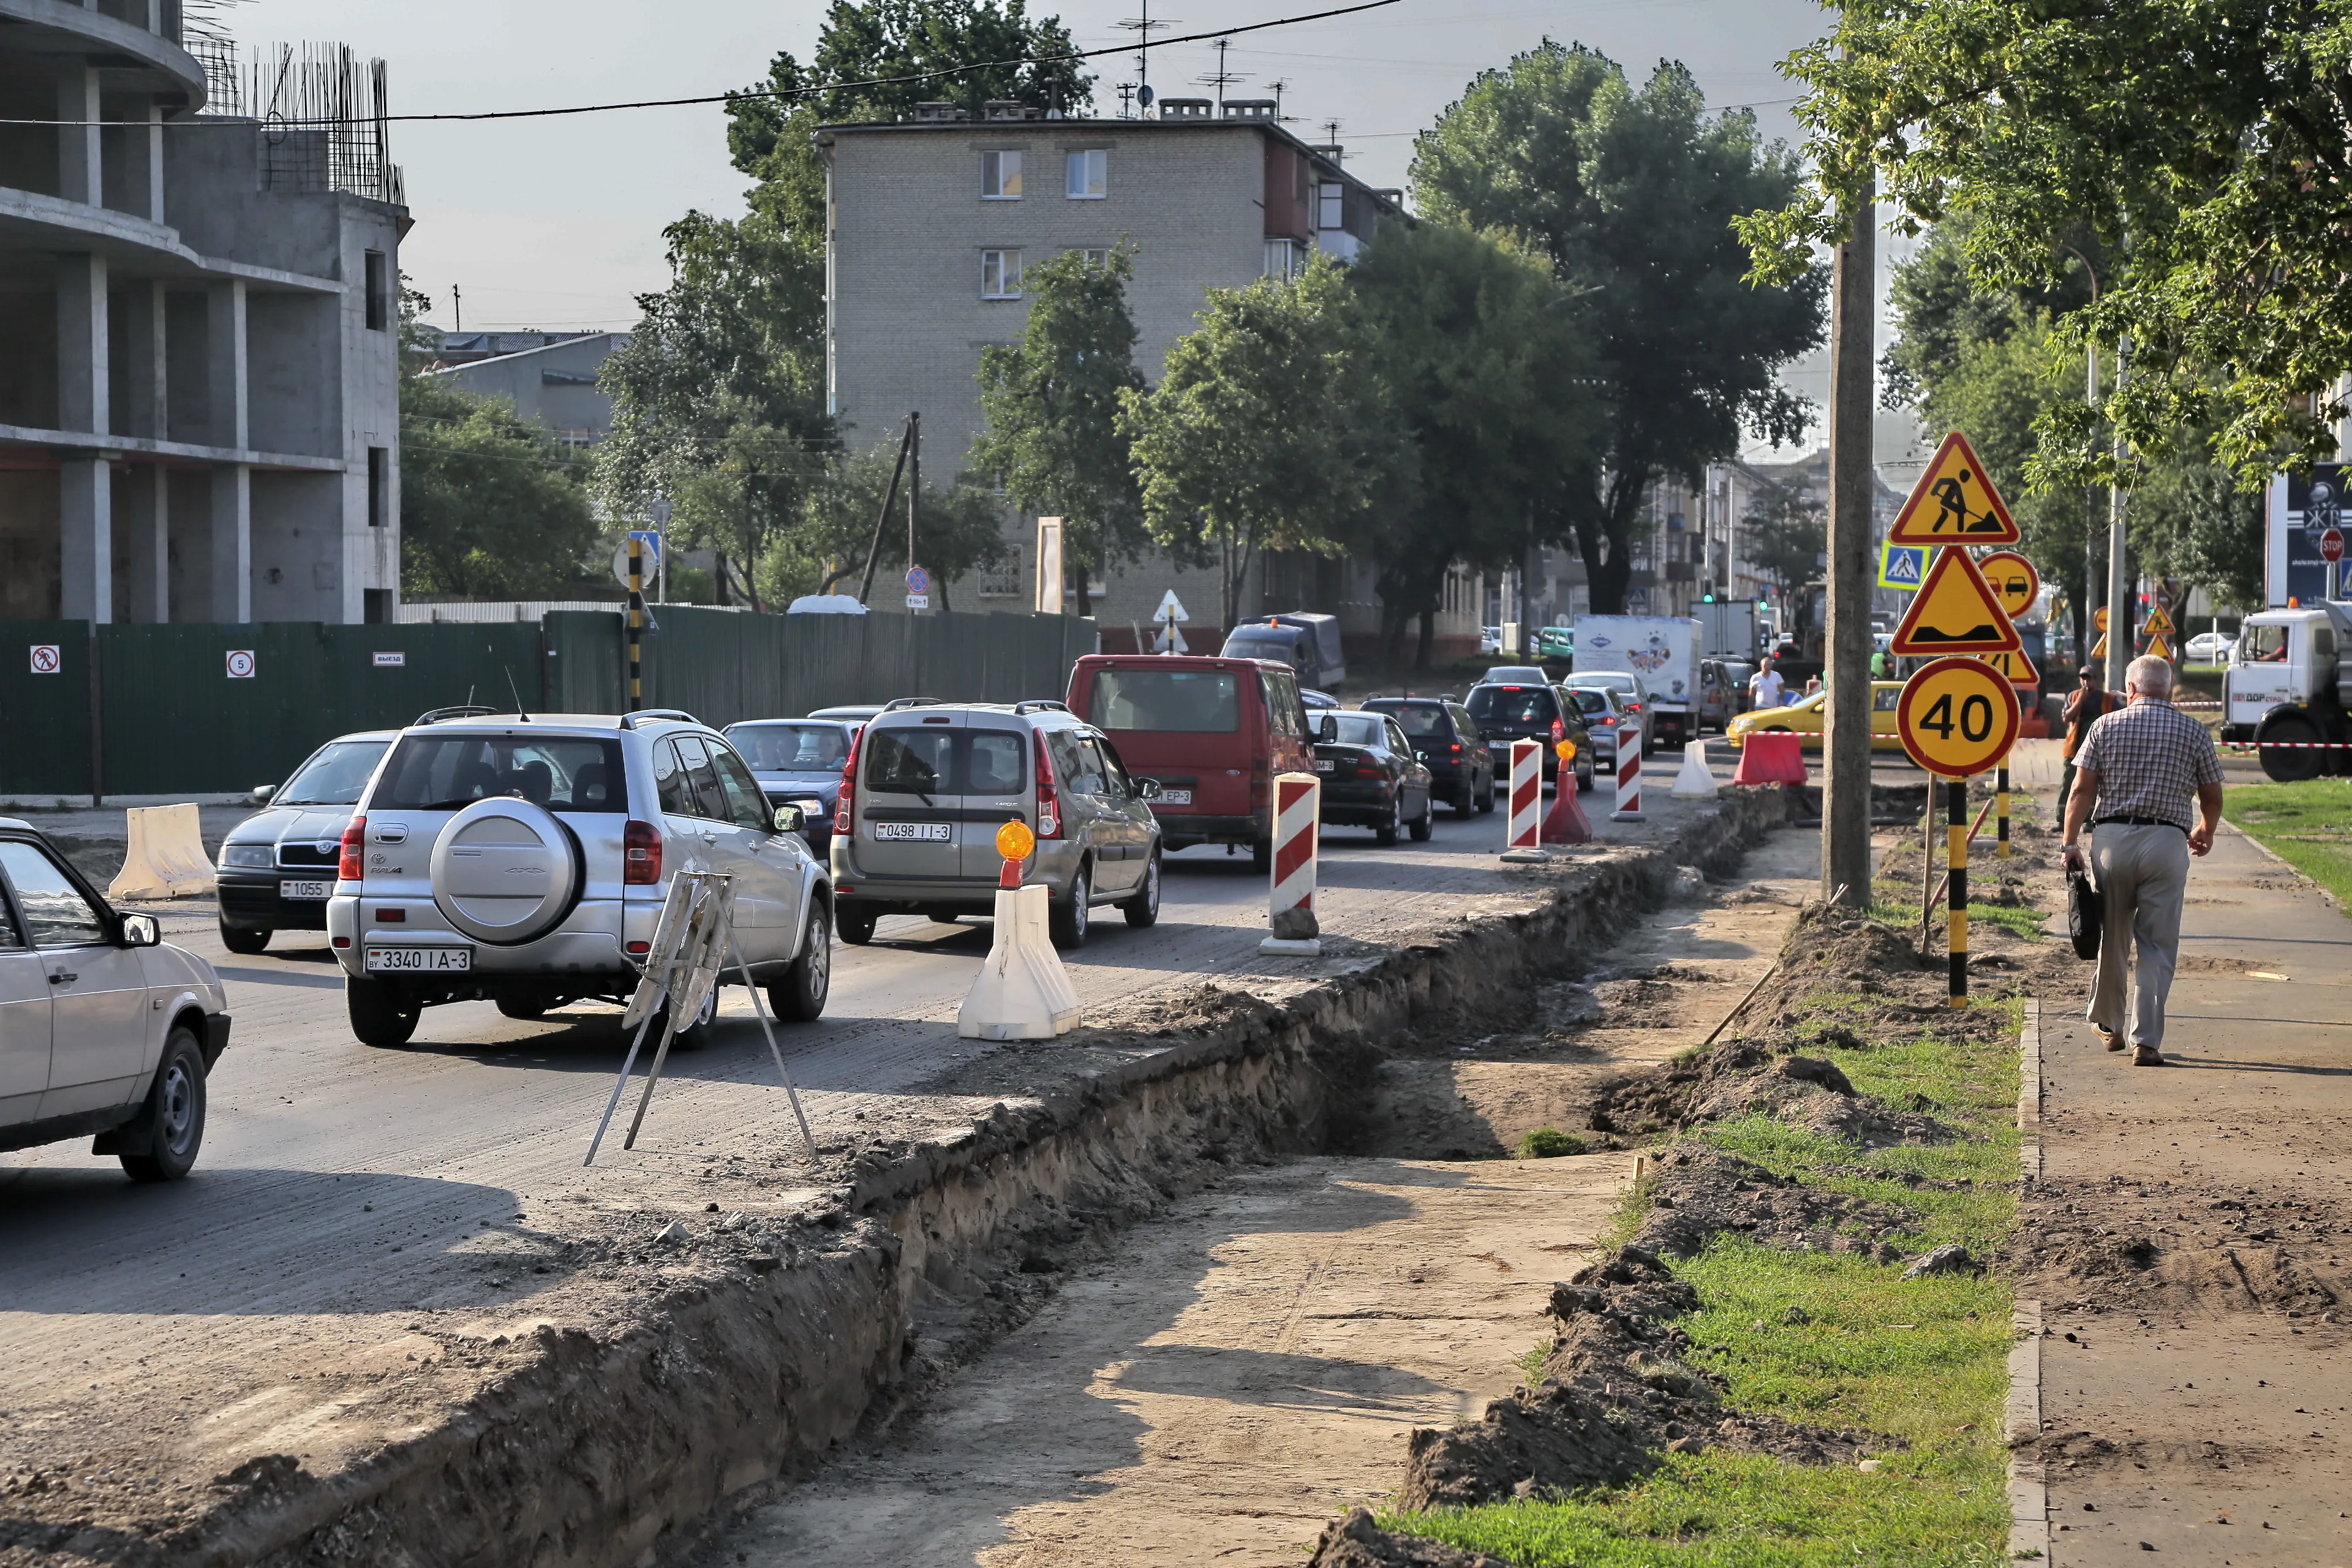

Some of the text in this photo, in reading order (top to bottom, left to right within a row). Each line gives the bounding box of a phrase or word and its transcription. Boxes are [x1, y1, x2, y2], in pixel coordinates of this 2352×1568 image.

[2323, 540, 2342, 551] STOP
[237, 660, 244, 669] 5
[1919, 693, 1993, 742] 40
[1167, 791, 1189, 801] EP-3
[887, 824, 914, 837] 0498
[294, 883, 323, 895] 1055
[383, 951, 421, 968] 3340
[429, 951, 467, 969] IA-3
